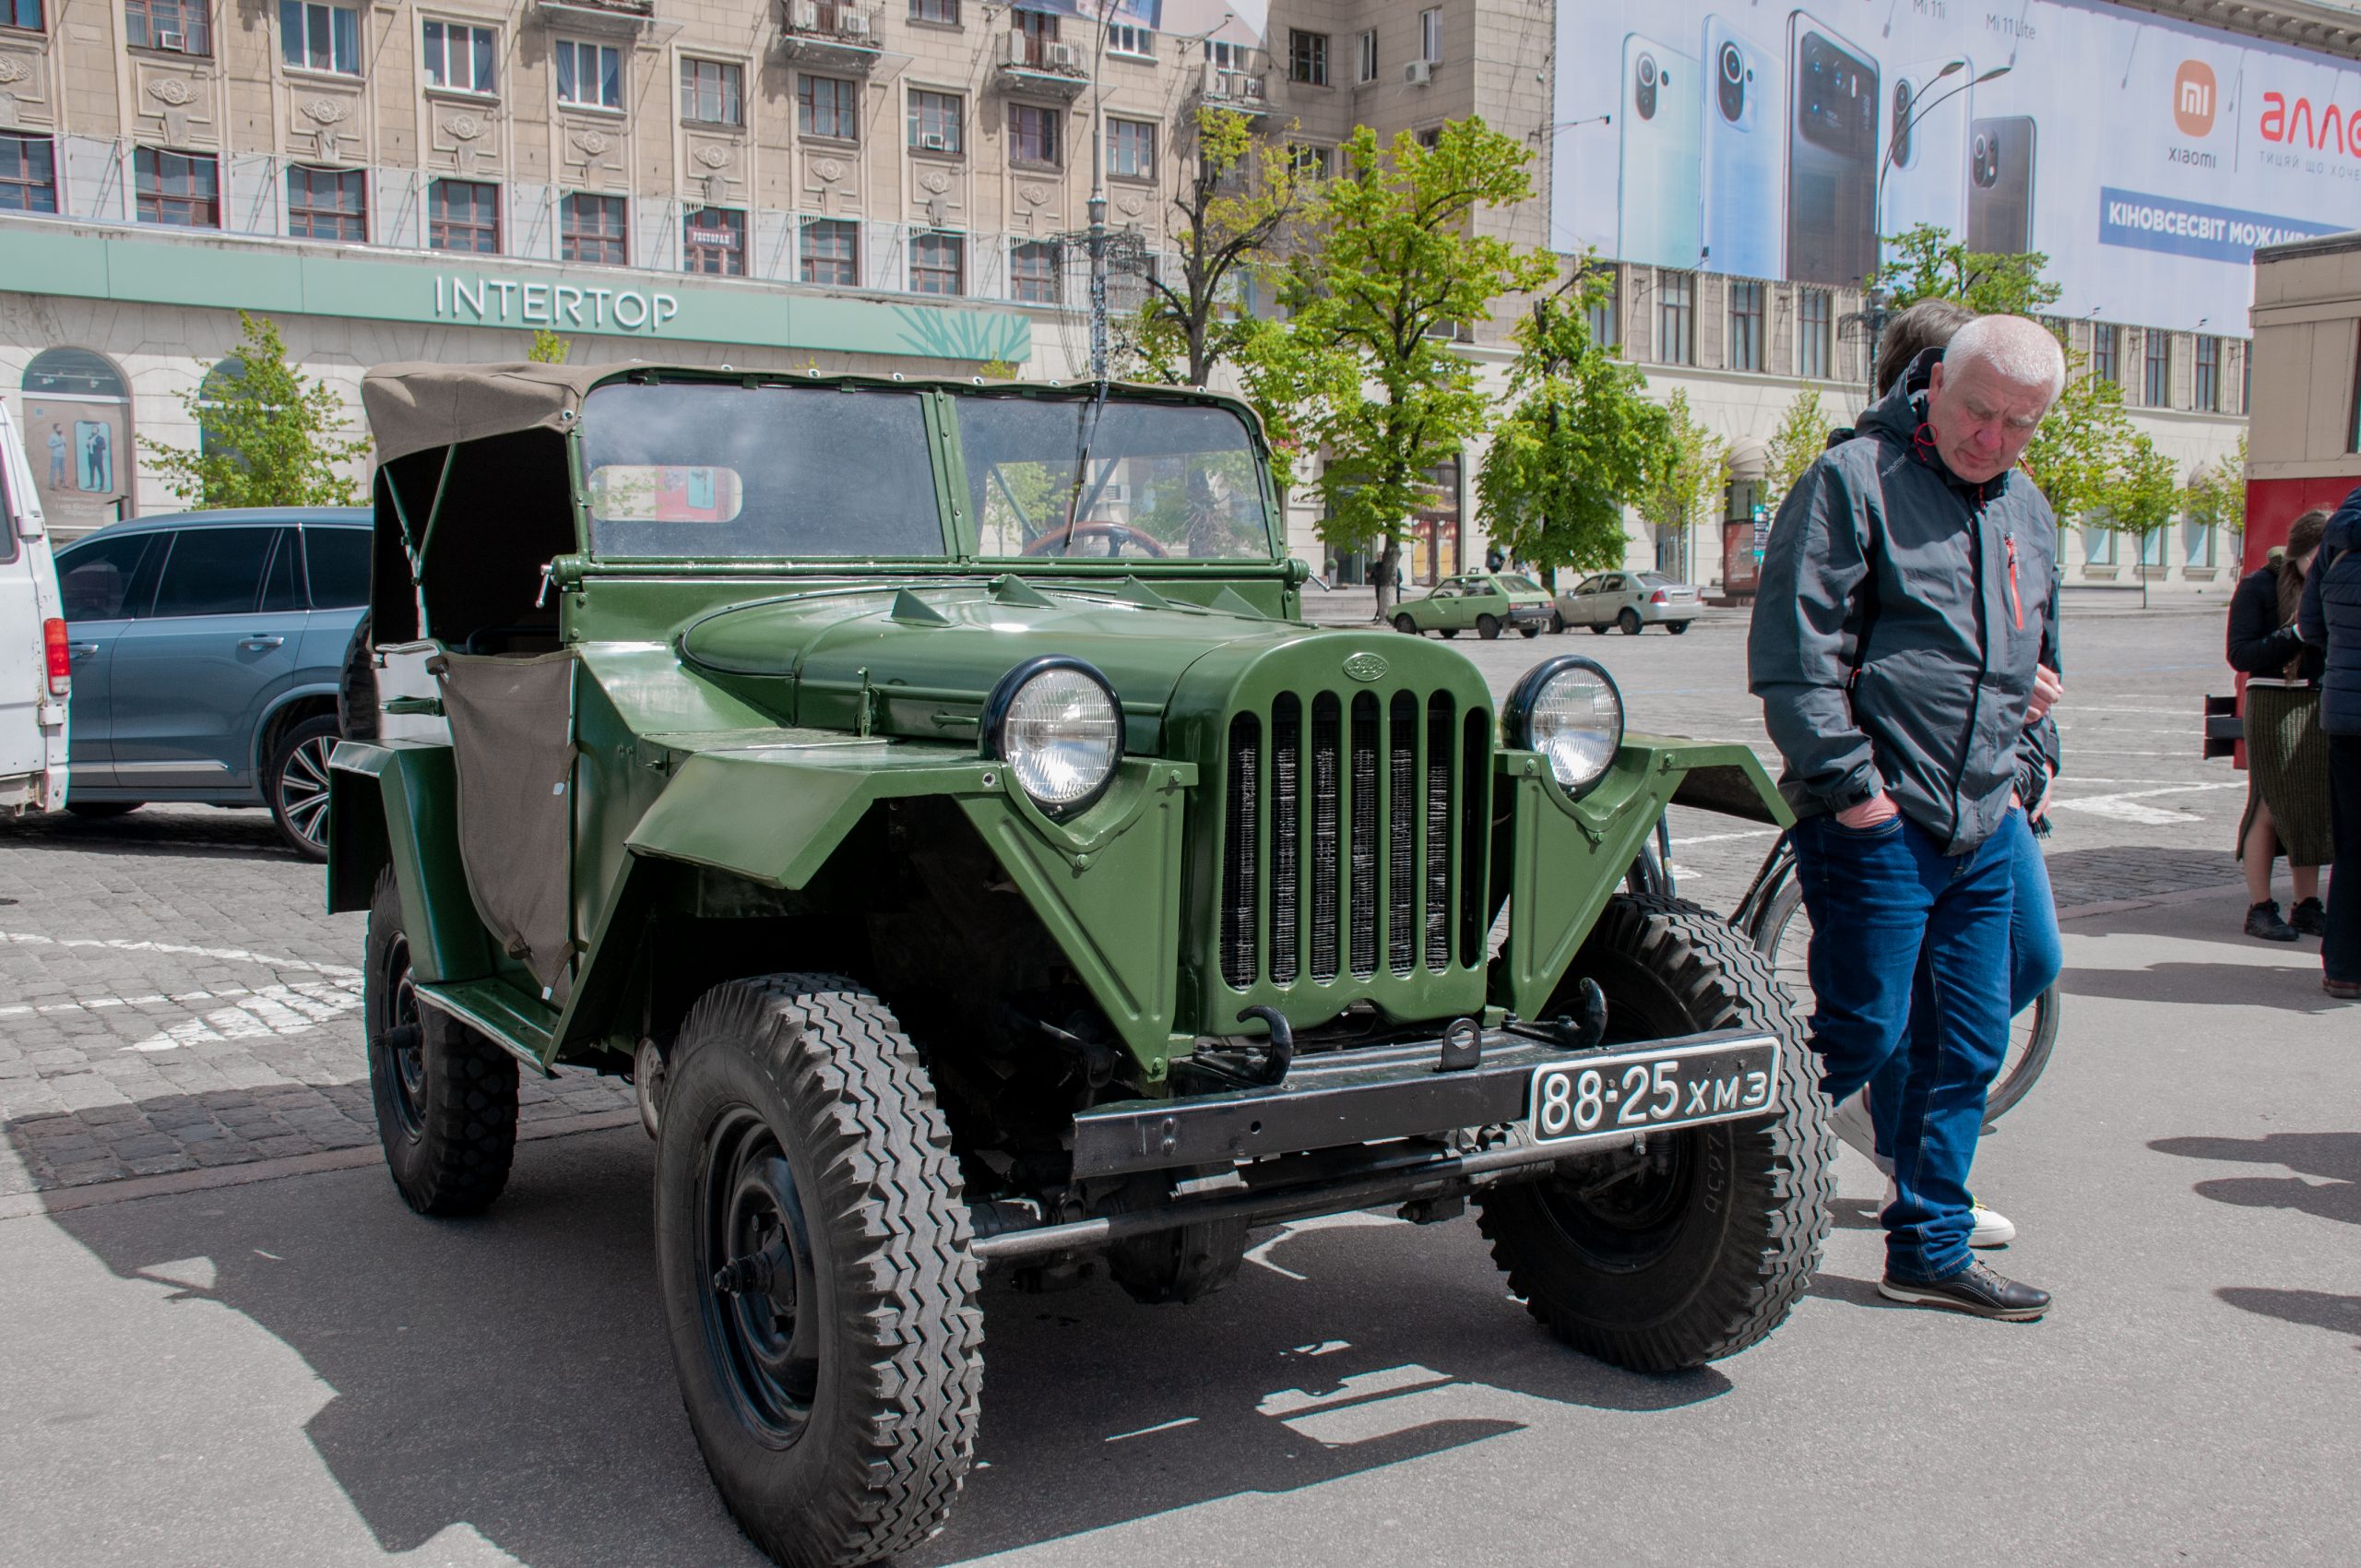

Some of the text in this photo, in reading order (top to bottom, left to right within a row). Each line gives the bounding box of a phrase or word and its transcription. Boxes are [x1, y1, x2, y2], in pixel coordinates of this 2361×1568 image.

[1914, 0, 1928, 15] Mi
[1986, 13, 2035, 40] Mi 11 Lite
[2260, 149, 2299, 170] ТИЦЯЙ
[2307, 160, 2323, 175] ЩО
[2108, 200, 2226, 243] КІНОВСЕСВІТ
[435, 275, 679, 329] INTERTOP
